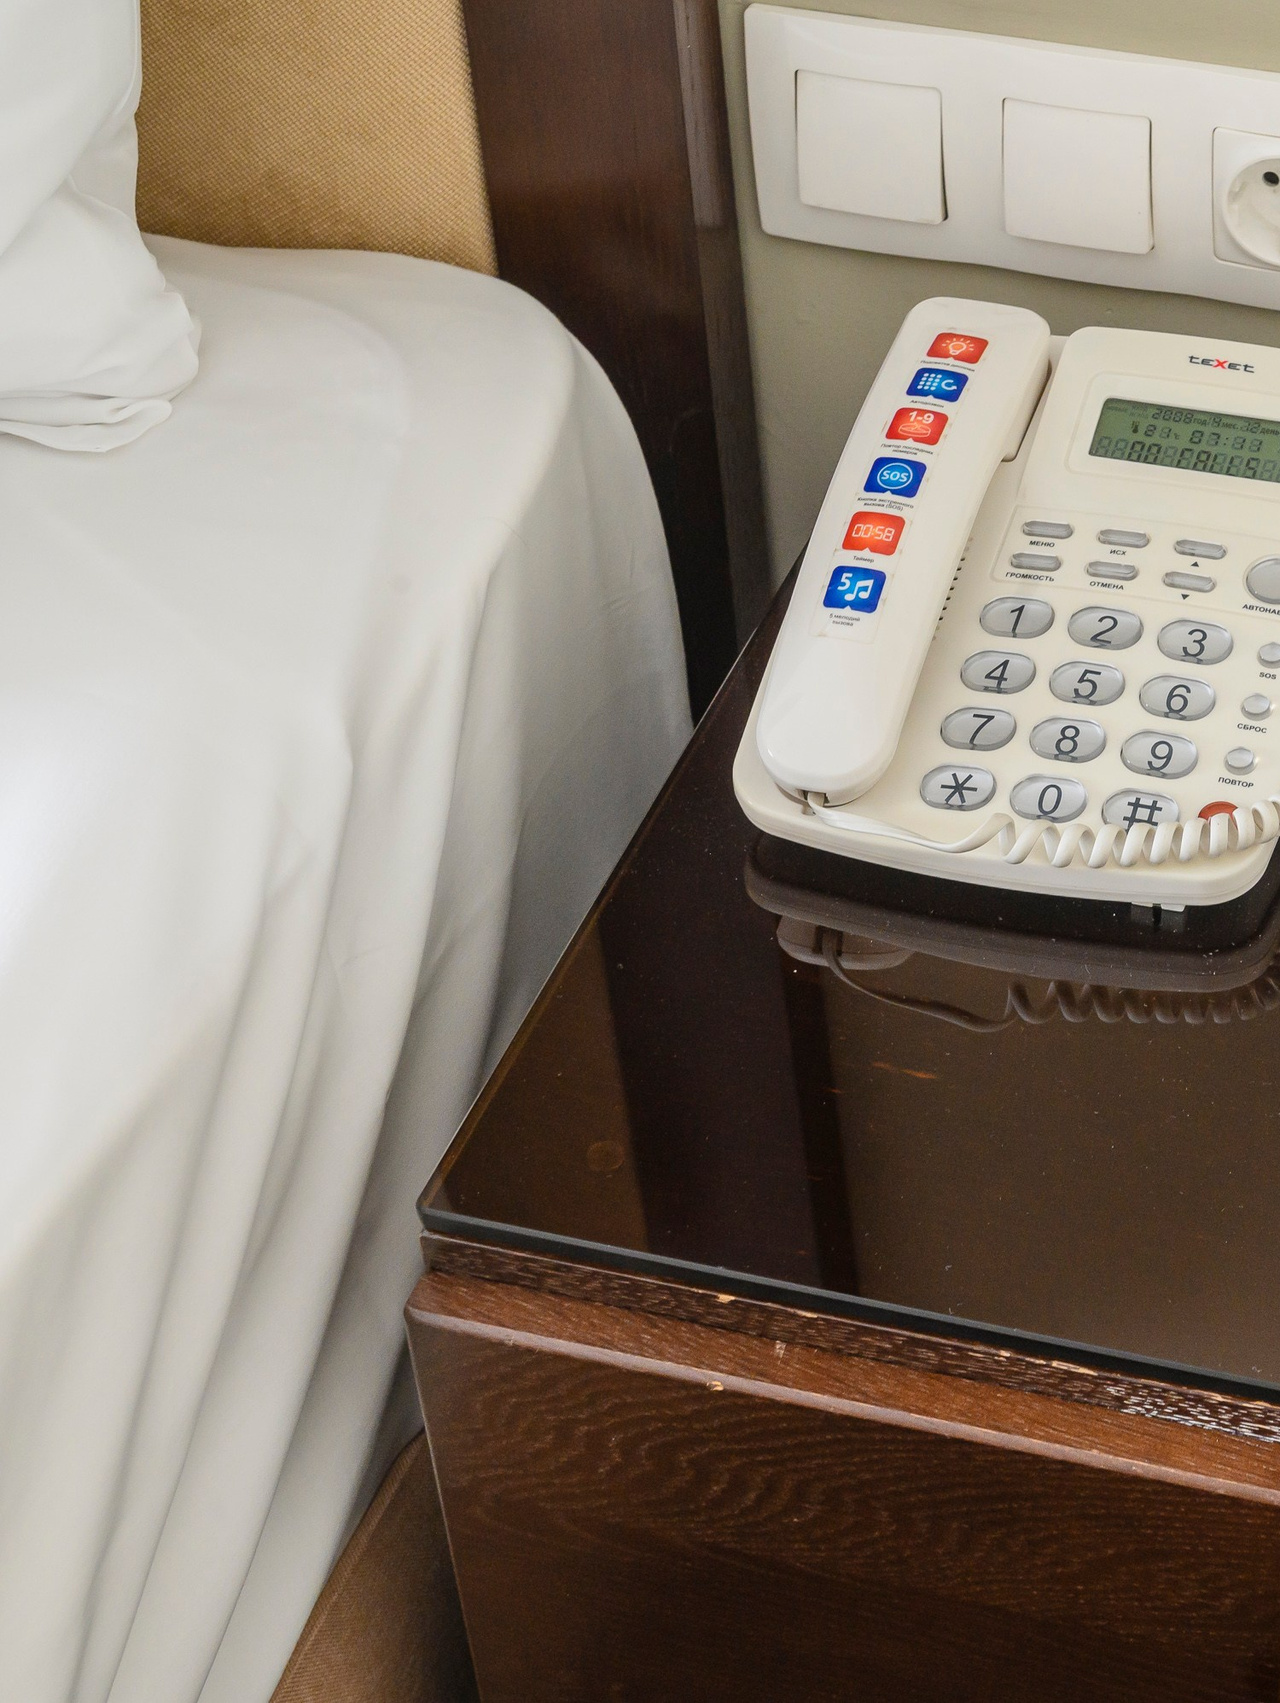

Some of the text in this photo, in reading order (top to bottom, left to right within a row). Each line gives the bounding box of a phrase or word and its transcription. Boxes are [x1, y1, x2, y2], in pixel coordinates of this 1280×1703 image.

[909, 410, 935, 425] 1-9
[881, 470, 909, 483] SOS
[852, 523, 896, 542] 00:58
[1029, 540, 1055, 548] МЕНЮ
[853, 555, 875, 564] Таймер
[837, 572, 853, 591] 5
[1005, 571, 1055, 582] ГРОМКОСТЬ
[1089, 580, 1125, 591] ОТМЕНА
[1010, 604, 1026, 634] 1
[1090, 615, 1119, 645] 2
[1182, 628, 1208, 658] 3
[984, 659, 1010, 690] 4
[1259, 672, 1277, 680] SOS
[1073, 669, 1102, 700] 5
[1166, 684, 1191, 714] 6
[969, 713, 996, 745] 7
[1237, 723, 1267, 734] СБРОС
[1055, 725, 1080, 756] 8
[1147, 740, 1174, 771] 9
[1218, 777, 1254, 788] ПОВТОР
[1038, 784, 1062, 815] 0
